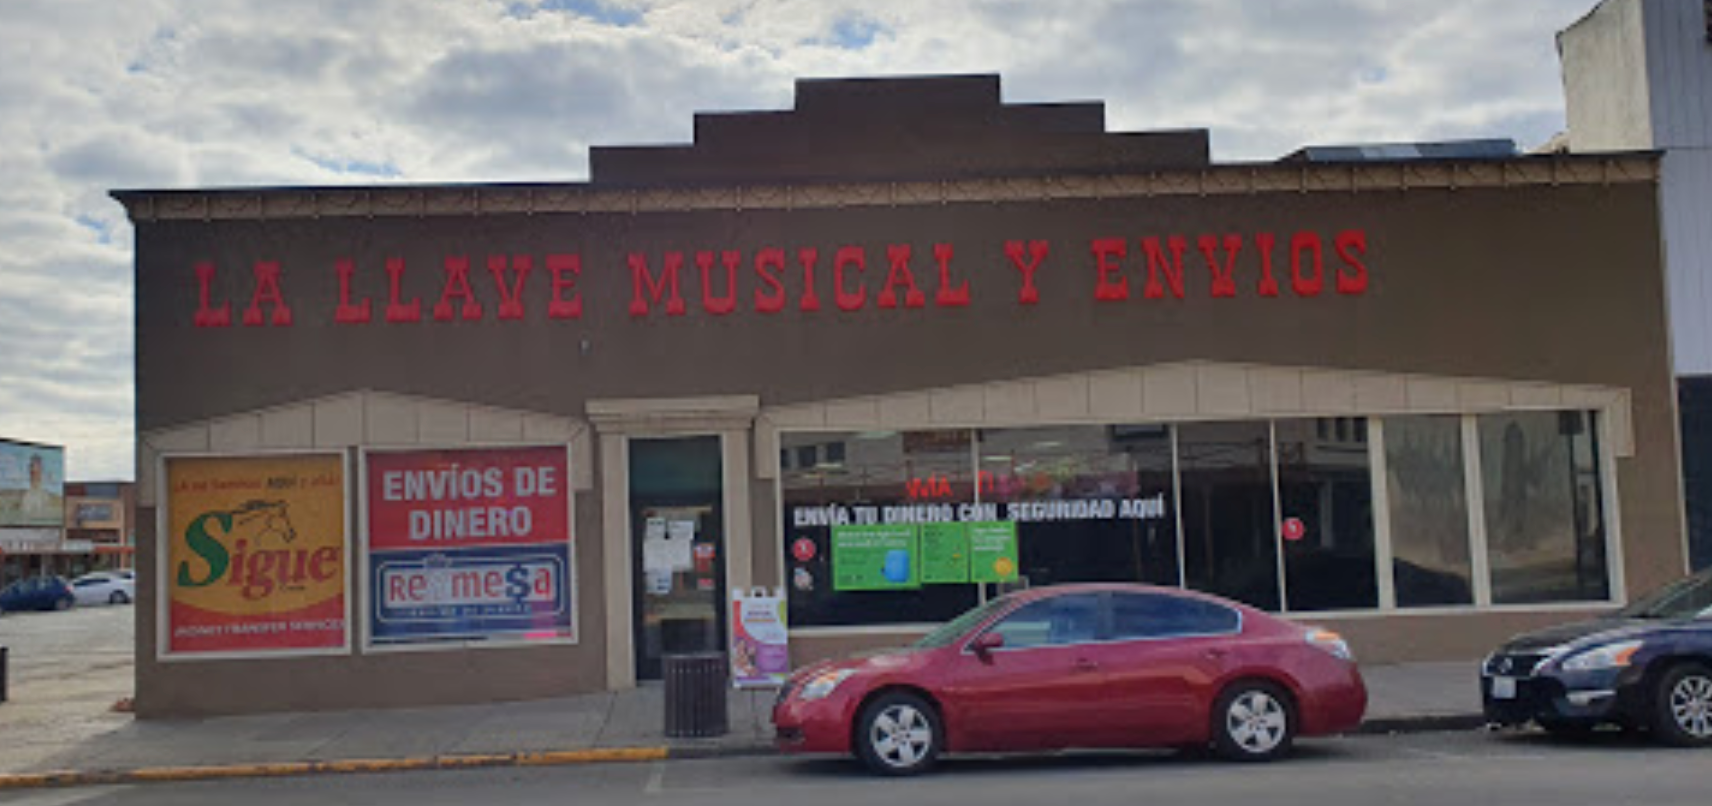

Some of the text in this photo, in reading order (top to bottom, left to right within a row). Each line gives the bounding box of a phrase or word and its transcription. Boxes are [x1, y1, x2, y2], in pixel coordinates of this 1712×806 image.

[193, 227, 1370, 328] LA LLAVE MUSICAL Y ENVIOS
[383, 463, 557, 501] ENVÍOS DE
[408, 505, 533, 541] DINERO
[794, 491, 1165, 527] ENVÍA TU DINERO CON SEGURIDAD AQUÍ
[177, 510, 342, 601] Sigue
